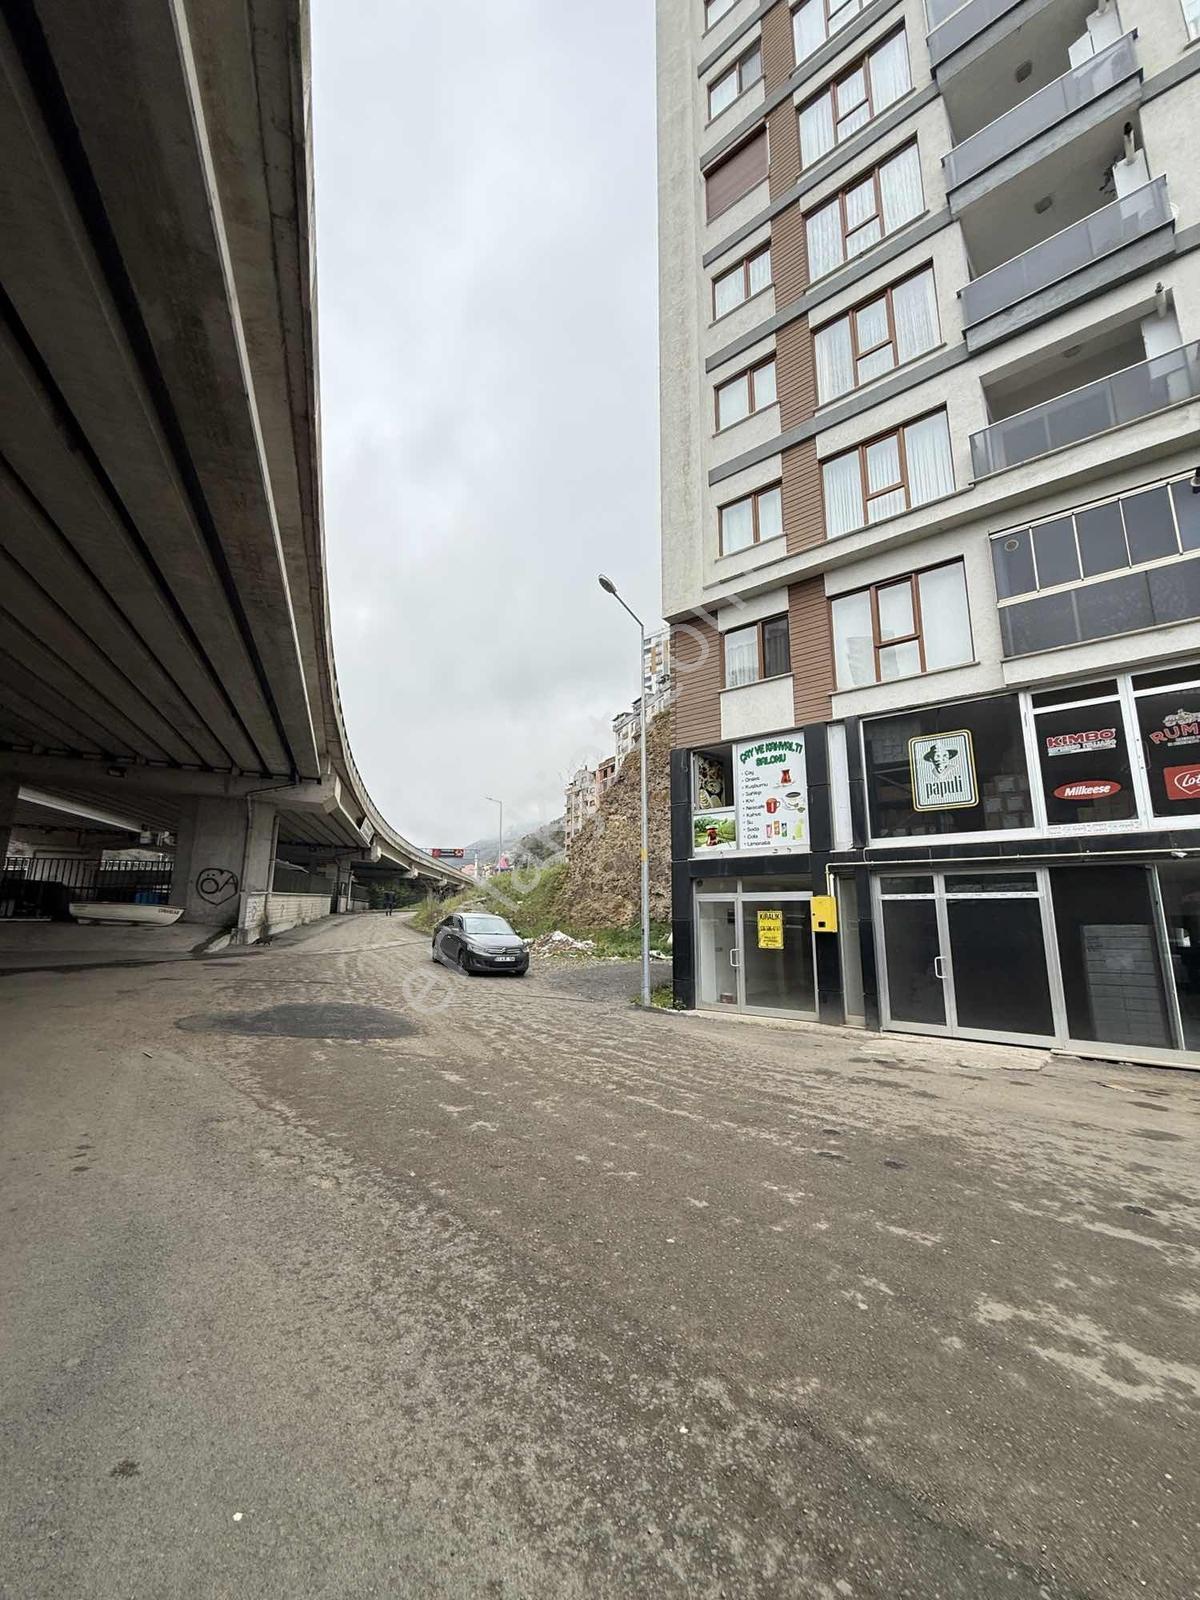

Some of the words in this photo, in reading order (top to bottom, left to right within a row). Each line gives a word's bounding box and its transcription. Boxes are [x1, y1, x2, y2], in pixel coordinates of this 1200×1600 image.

[1047, 728, 1116, 748] KIMBO
[755, 743, 765, 755] VE
[756, 753, 787, 767] SALONU
[926, 776, 963, 799] papuli
[1064, 785, 1111, 797] Milkeese
